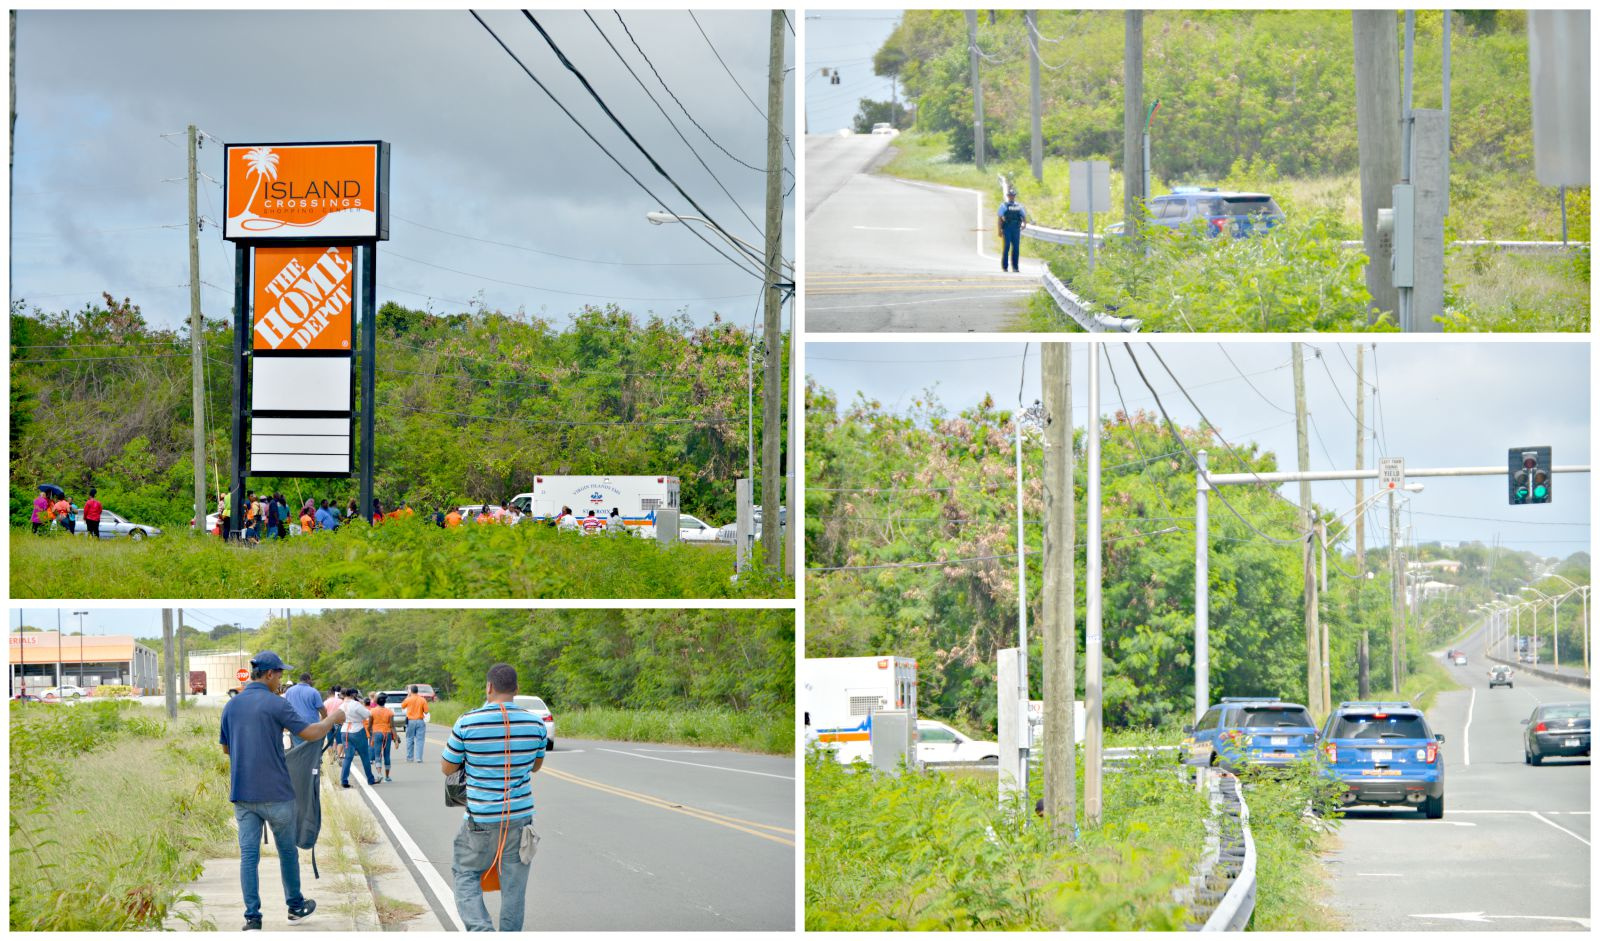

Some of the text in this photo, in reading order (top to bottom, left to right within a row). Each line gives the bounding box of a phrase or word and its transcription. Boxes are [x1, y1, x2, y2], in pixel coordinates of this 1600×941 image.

[264, 180, 361, 199] ISLAND
[264, 198, 362, 208] CROSSINGS
[264, 257, 306, 299] THE
[253, 246, 353, 350] HOME
[291, 284, 352, 350] DEPOT
[573, 485, 590, 495] VIRGIN
[611, 487, 621, 495] EMS
